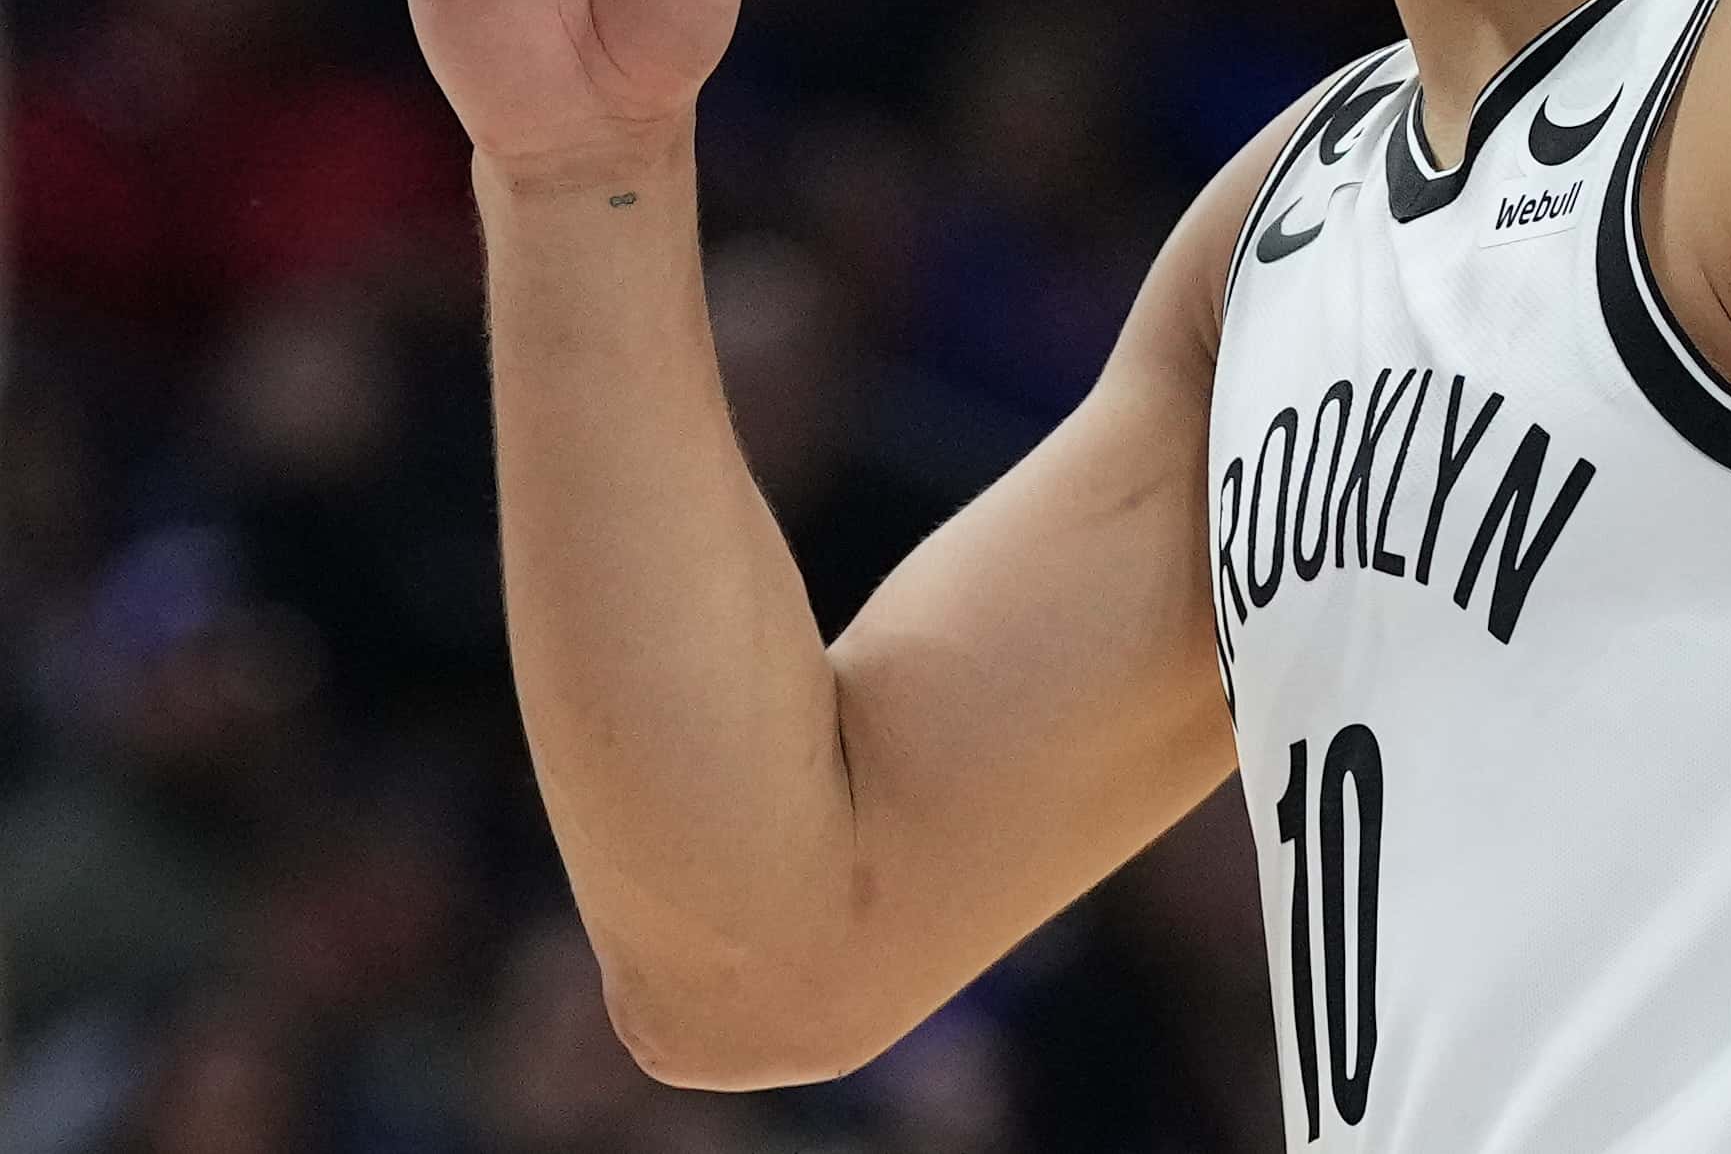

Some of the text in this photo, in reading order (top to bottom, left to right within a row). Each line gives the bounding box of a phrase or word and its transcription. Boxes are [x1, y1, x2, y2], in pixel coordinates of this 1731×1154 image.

[1495, 179, 1584, 231] Webull
[1217, 367, 1596, 665] ROOKLYN
[1276, 723, 1384, 1144] 10
